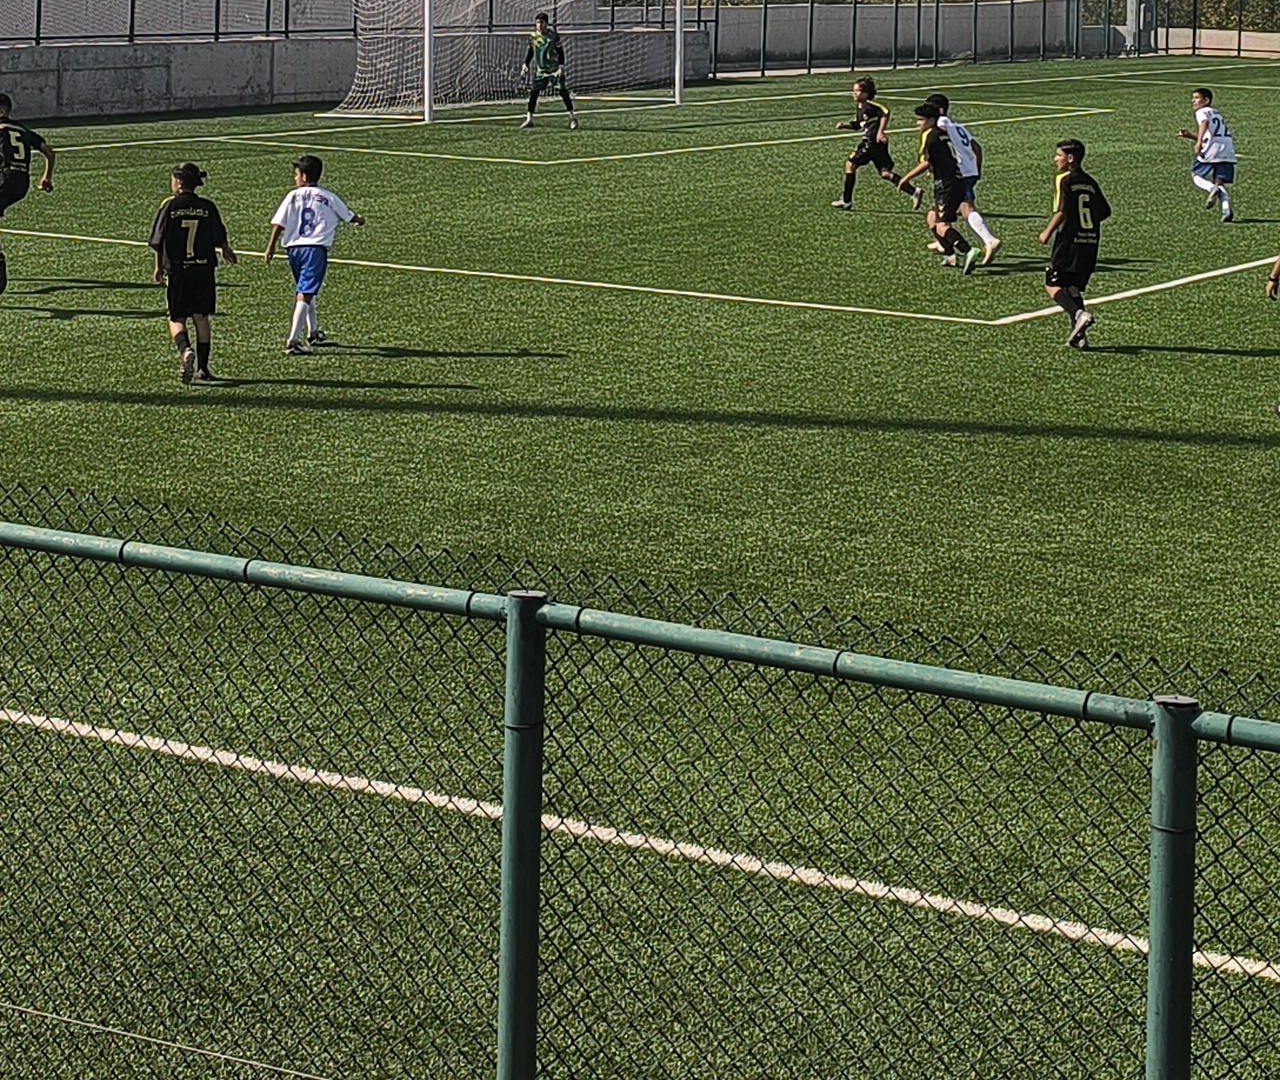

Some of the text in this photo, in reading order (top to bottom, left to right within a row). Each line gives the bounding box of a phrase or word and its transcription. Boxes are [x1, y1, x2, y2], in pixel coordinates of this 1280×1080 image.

[9, 131, 25, 159] 5
[956, 126, 969, 147] 9
[299, 207, 316, 238] 8
[1078, 194, 1093, 229] 6
[180, 219, 199, 258] 7
